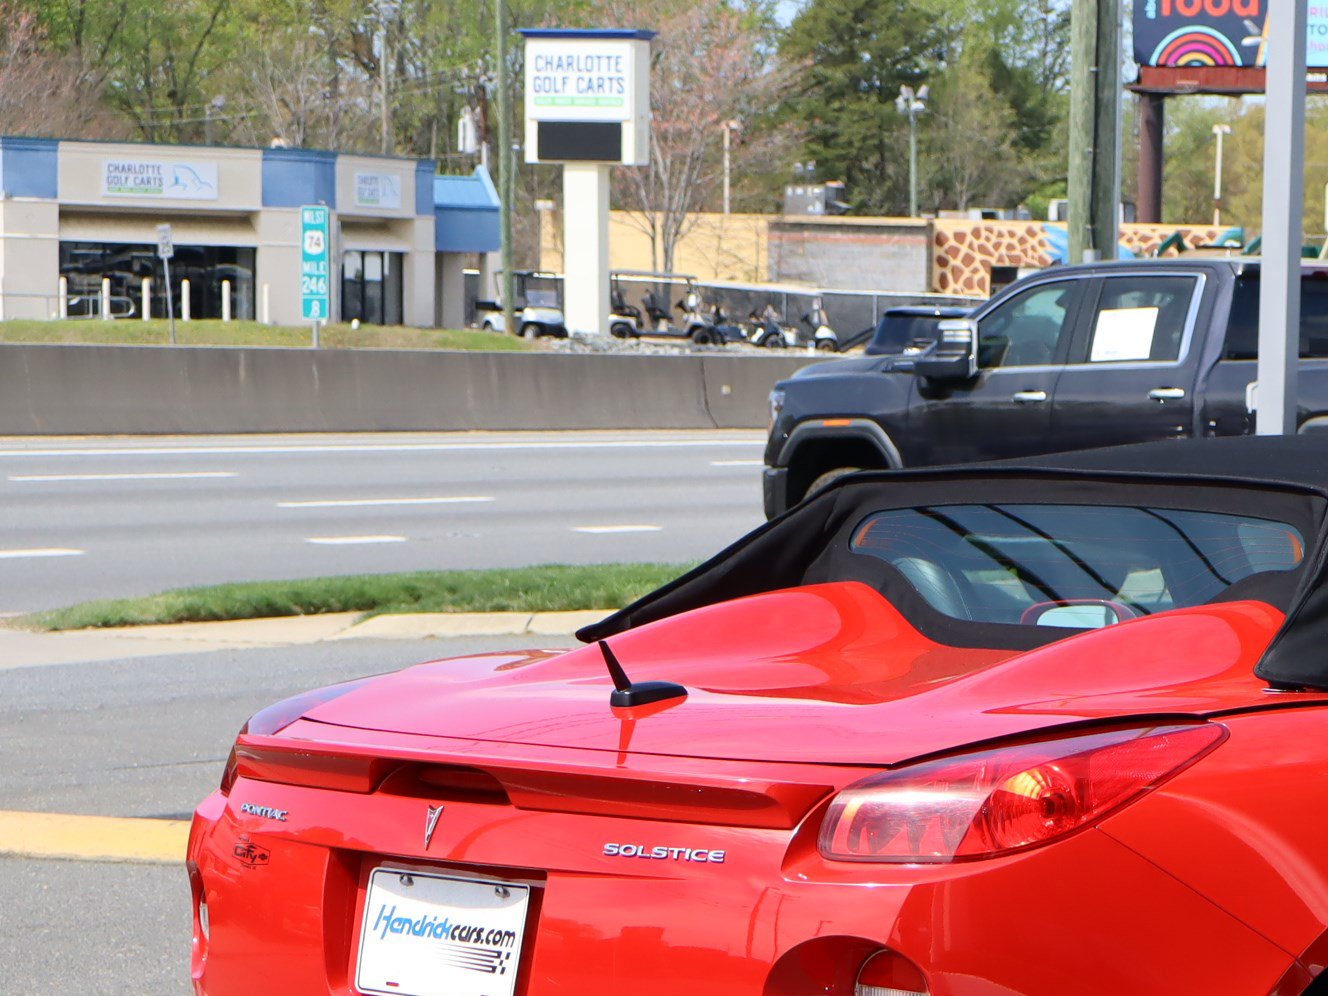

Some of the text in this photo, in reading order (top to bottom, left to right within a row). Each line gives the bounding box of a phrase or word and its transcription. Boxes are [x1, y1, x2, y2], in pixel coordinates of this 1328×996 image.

[535, 55, 623, 73] CHARLOTTE
[533, 75, 625, 94] GOLF CARTS
[107, 163, 163, 176] CHARLOTTE
[106, 175, 164, 188] GOLF CARTS
[308, 235, 321, 249] 74
[302, 261, 327, 276] MILE
[302, 275, 327, 294] 246
[241, 803, 289, 822] PONTIAC
[602, 842, 727, 863] SOLSTICE
[373, 904, 516, 948] Hendrickcars.com
